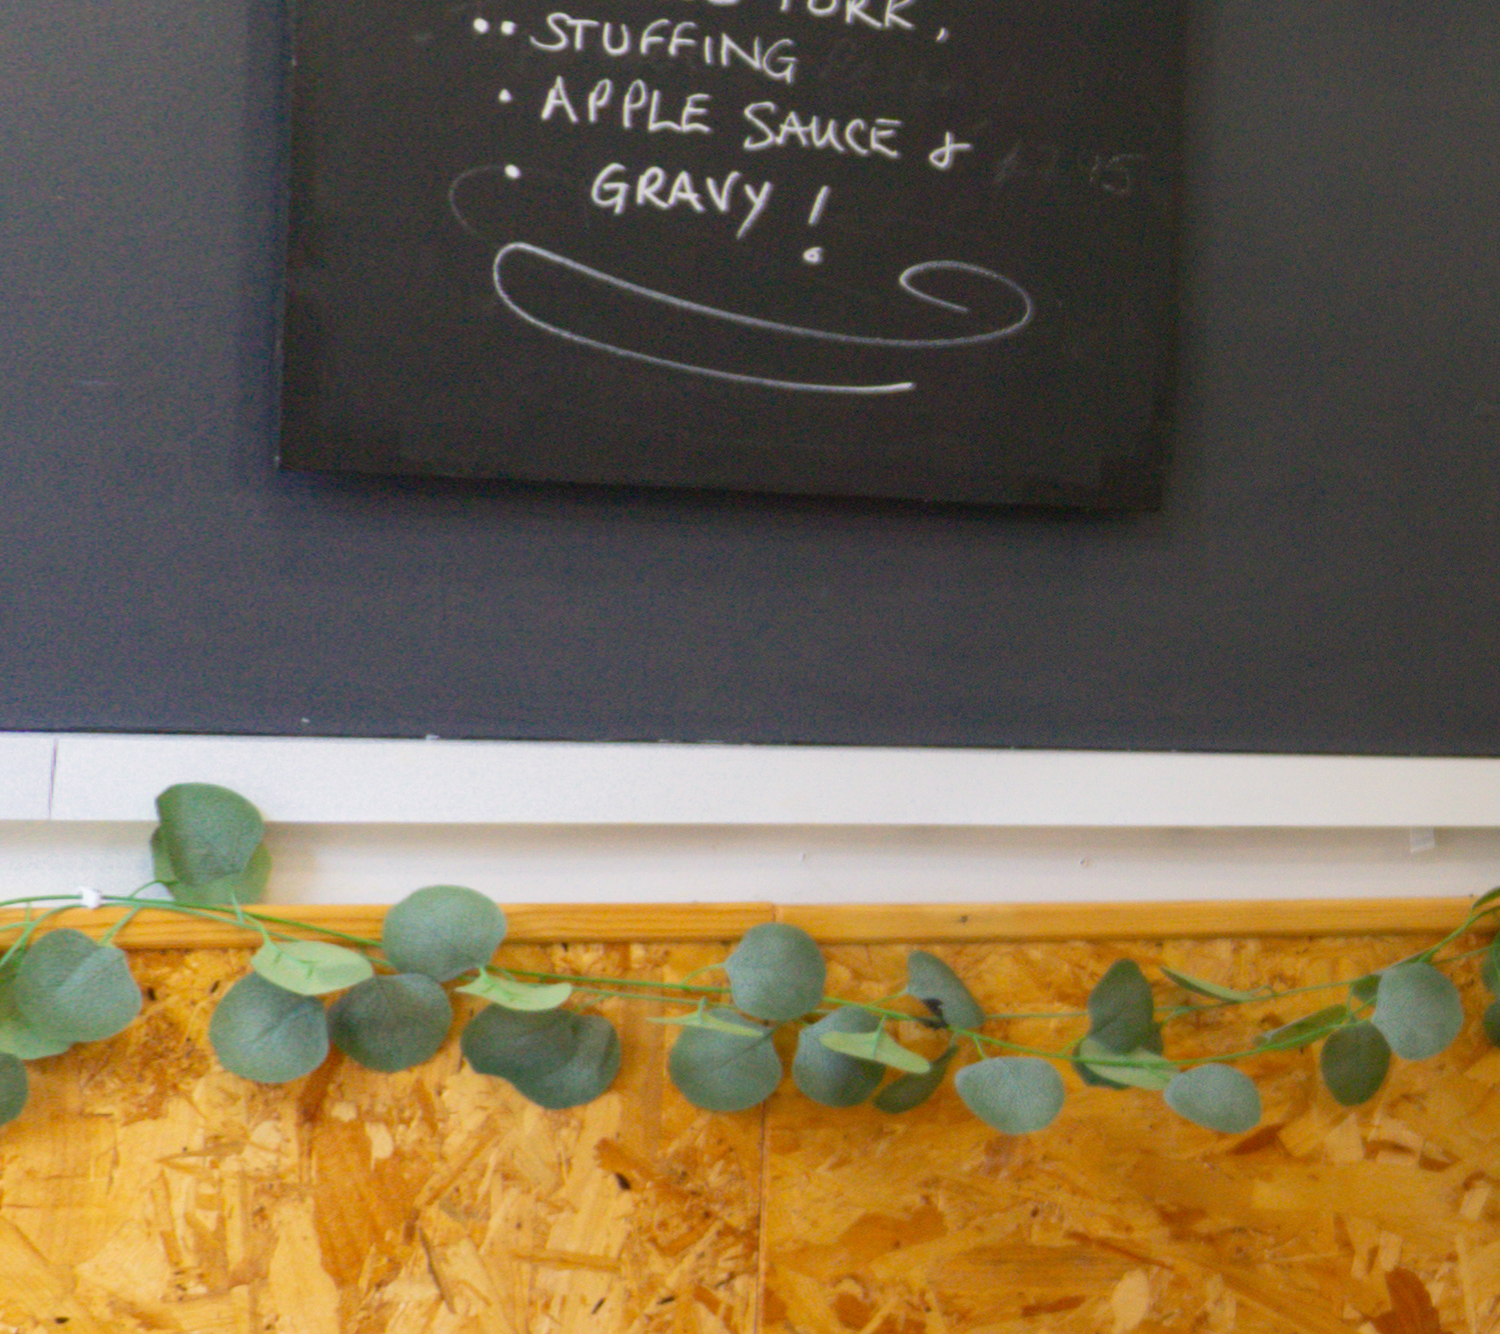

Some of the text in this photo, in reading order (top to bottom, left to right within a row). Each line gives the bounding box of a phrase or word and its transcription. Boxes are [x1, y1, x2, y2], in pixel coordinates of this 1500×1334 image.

[529, 11, 796, 84] STUFFING
[540, 77, 711, 133] APPLE
[742, 100, 901, 158] SAUCE
